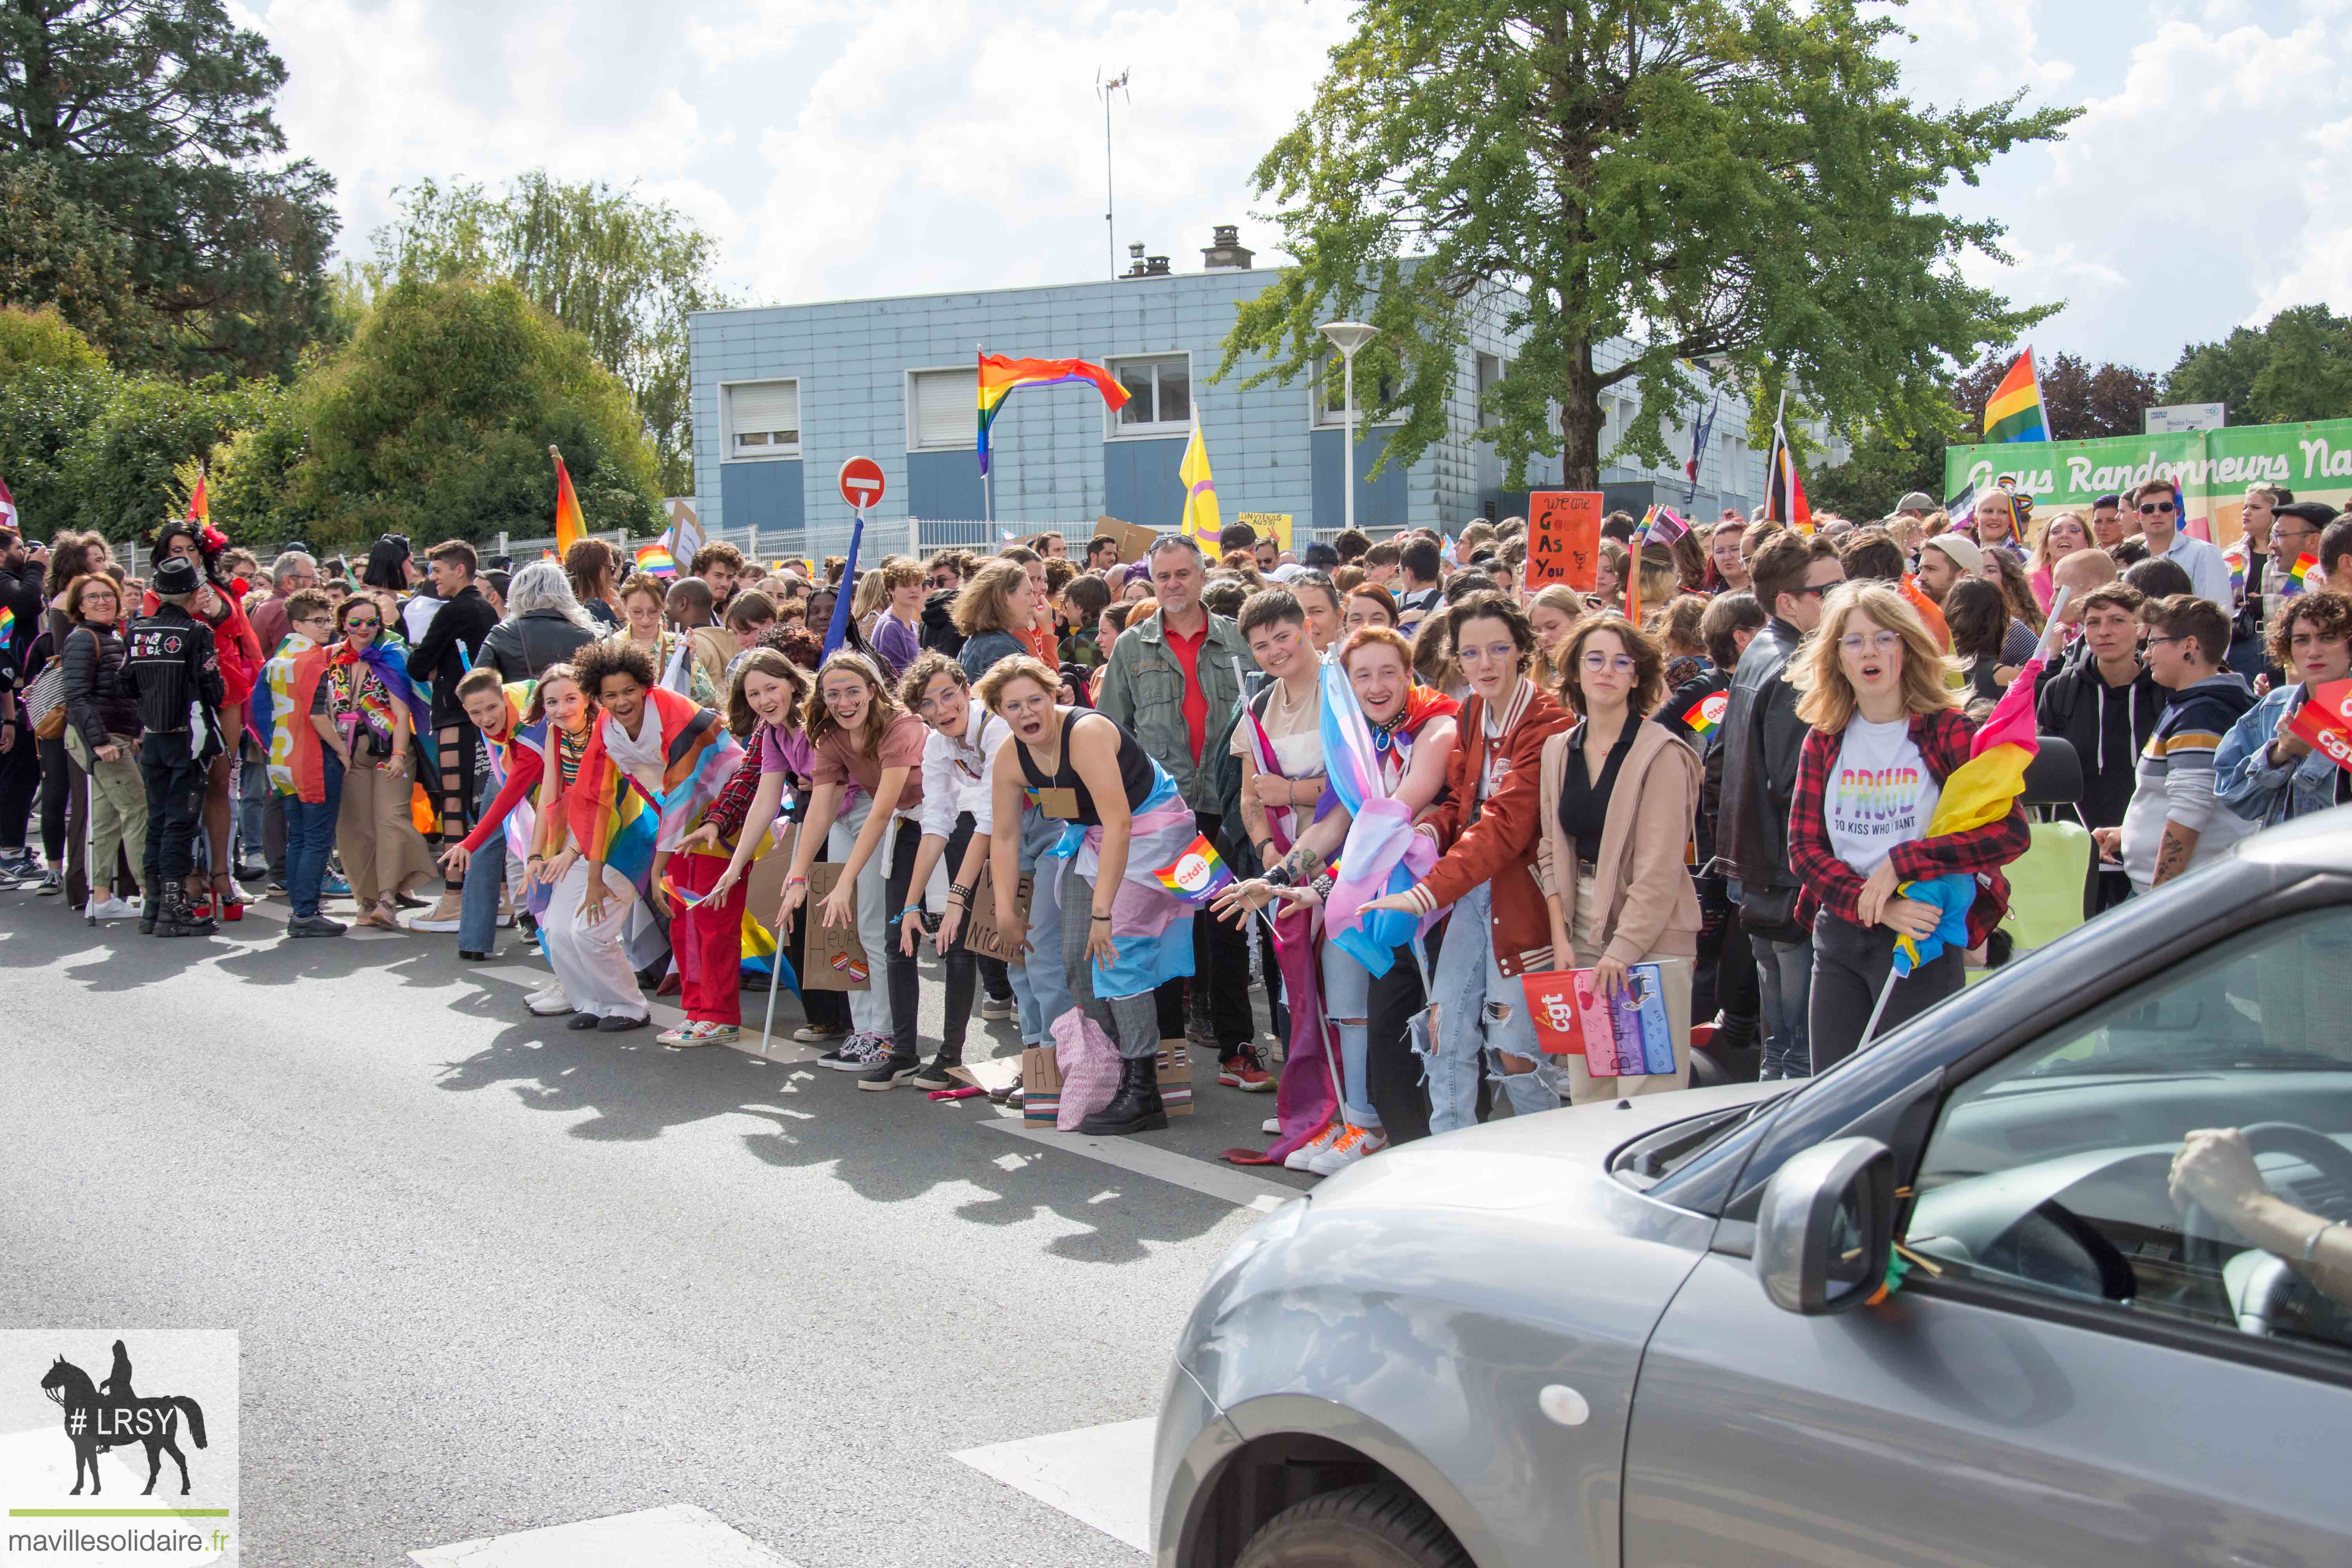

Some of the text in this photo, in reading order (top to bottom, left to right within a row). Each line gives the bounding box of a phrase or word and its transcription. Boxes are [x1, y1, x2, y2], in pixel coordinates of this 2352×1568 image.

[2066, 451, 2290, 493] Randonneurs
[1544, 497, 1591, 510] we are
[368, 710, 389, 729] cgt
[1835, 768, 1918, 820] PROUD
[1835, 817, 1915, 835] TO KISS WHO I WANT
[1541, 993, 1572, 1032] cgt
